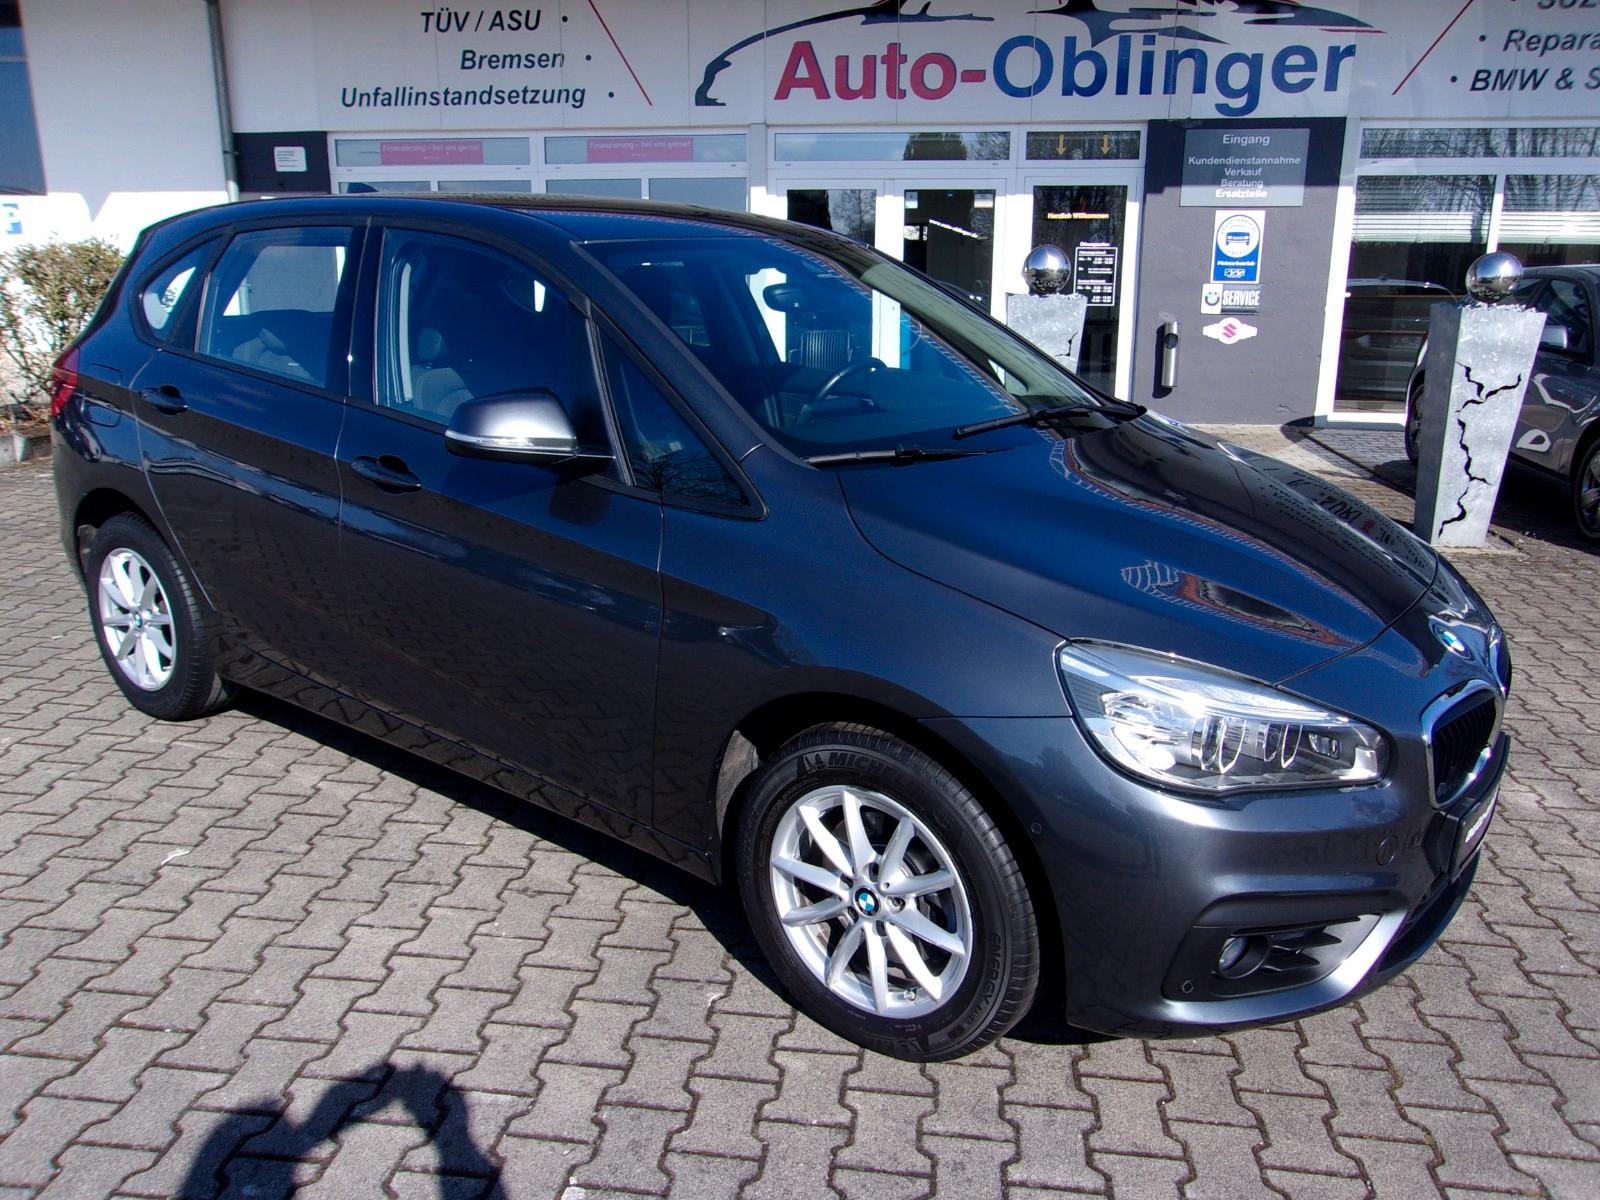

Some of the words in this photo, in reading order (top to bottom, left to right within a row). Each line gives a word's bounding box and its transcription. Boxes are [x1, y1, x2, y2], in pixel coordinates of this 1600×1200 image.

[420, 8, 470, 33] TÜV
[488, 9, 542, 32] ASU
[460, 49, 565, 71] Bremsen
[1469, 68, 1550, 92] BMW
[1554, 67, 1574, 91] &
[341, 85, 587, 109] Unfallinstandsetzung
[1222, 134, 1271, 147] Eingang
[1188, 156, 1301, 165] Kundendienstannahme
[1224, 167, 1262, 177] Verkauf
[1221, 178, 1264, 188] Beratung
[1215, 188, 1268, 199] Ersatzteile
[1222, 290, 1261, 306] SERVICE
